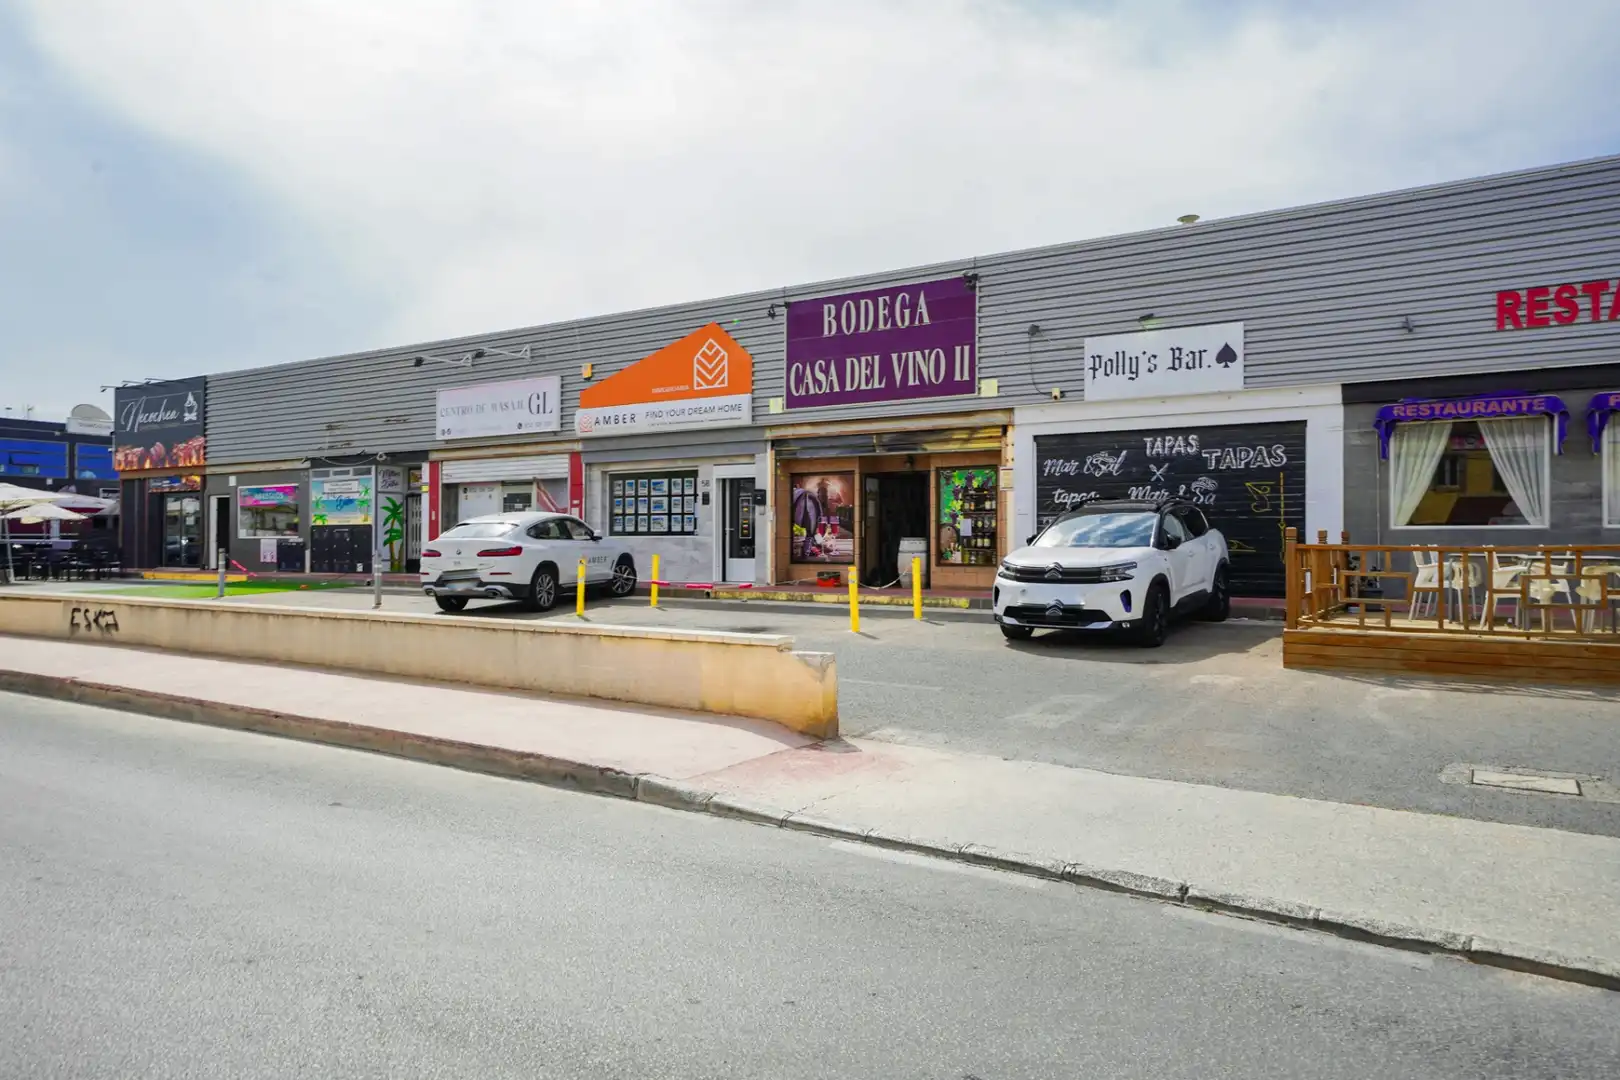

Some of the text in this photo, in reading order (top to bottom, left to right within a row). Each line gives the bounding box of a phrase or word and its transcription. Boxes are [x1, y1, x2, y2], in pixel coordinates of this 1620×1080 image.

[822, 290, 931, 337] BODEGA
[790, 345, 970, 396] CASA DEL VINO II
[1089, 346, 1212, 381] Polly's Bar.
[120, 396, 180, 432] Necochea
[440, 405, 473, 417] CENTRO
[528, 391, 553, 415] GL
[645, 403, 743, 419] FIND YOUR DREAM HOME
[1393, 398, 1546, 417] RESTAURANTE
[594, 413, 636, 426] AMBER
[1143, 434, 1200, 457] TAPAS
[1201, 444, 1288, 470] TAPAS
[1043, 458, 1080, 477] Mar
